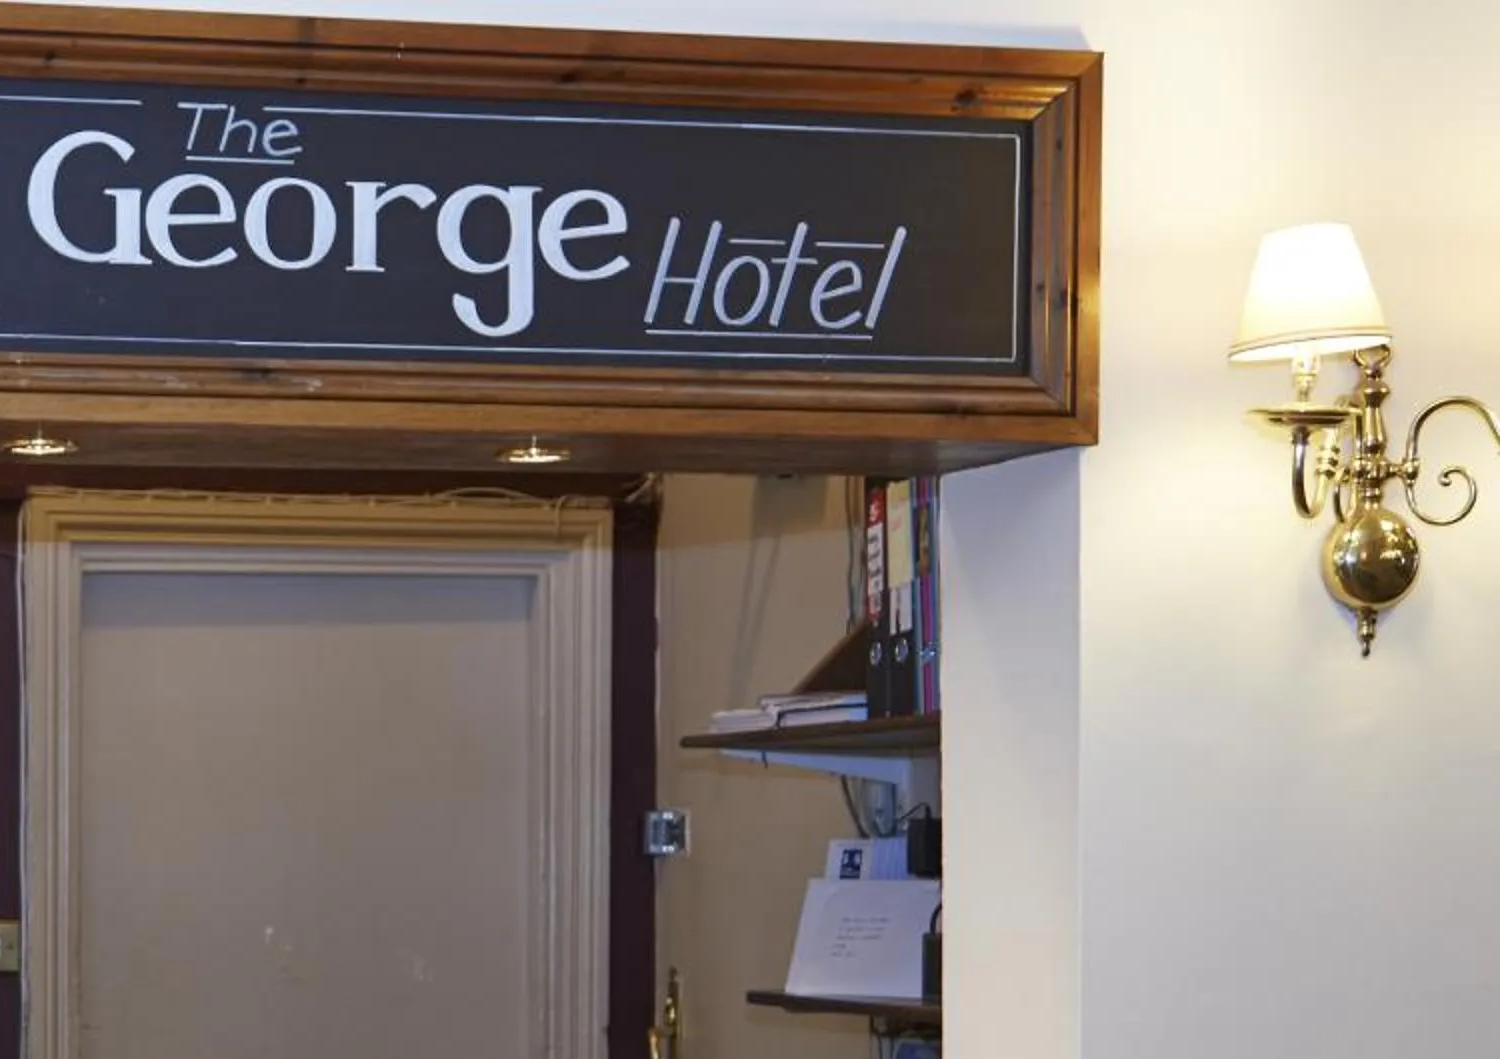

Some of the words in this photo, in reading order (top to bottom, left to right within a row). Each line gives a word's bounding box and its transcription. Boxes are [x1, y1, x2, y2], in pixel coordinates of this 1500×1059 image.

[178, 102, 303, 156] The
[27, 130, 630, 337] George
[644, 217, 907, 330] Hotel
